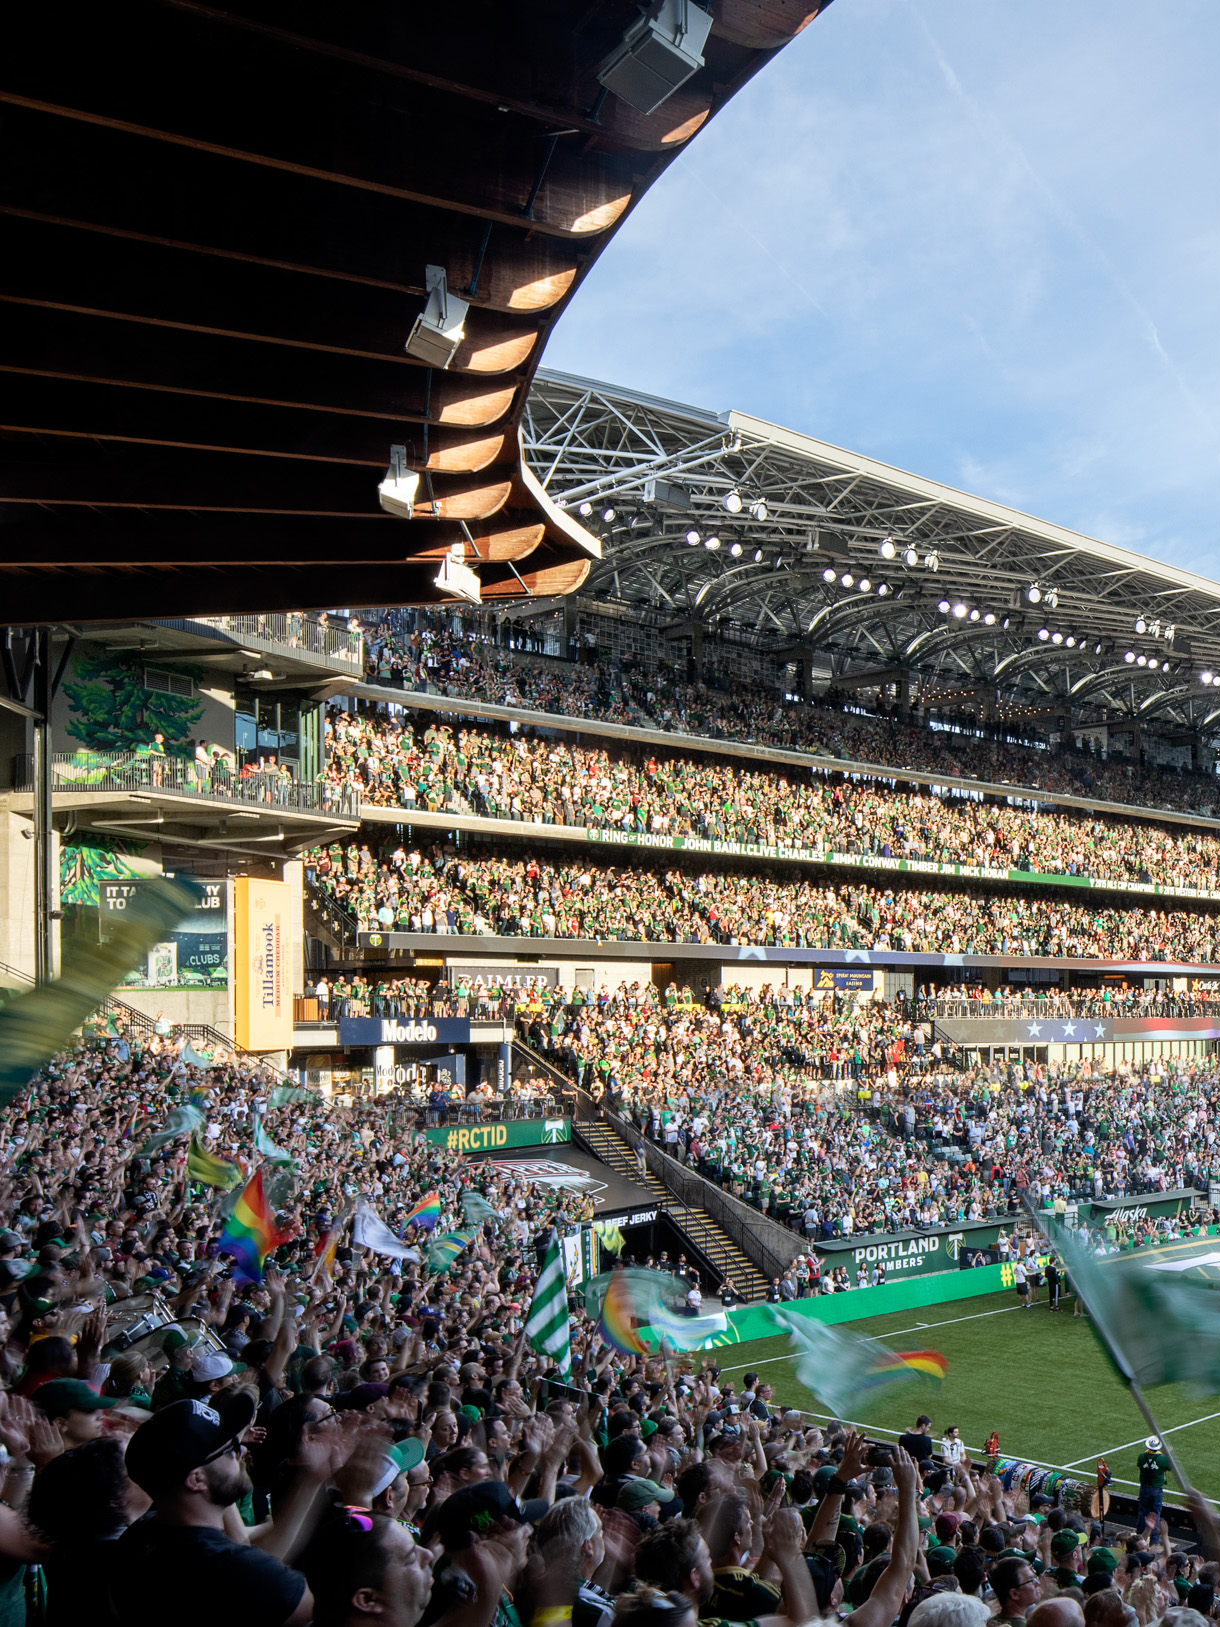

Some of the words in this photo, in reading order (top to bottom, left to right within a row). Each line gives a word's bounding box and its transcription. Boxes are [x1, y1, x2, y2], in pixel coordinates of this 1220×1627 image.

[602, 829, 628, 844] RING
[637, 833, 673, 848] HONOR
[681, 838, 712, 852] JOHN
[713, 841, 741, 854] BAIN
[746, 843, 777, 858] CLIVE
[778, 847, 825, 862] CHARLES
[831, 852, 861, 866] JIMMY
[862, 857, 900, 870] CONWAY
[905, 860, 938, 873] TIMBER
[939, 863, 955, 874] JIM
[959, 865, 980, 877] MICK
[980, 868, 1009, 880] HOBAN
[106, 886, 119, 897] IT
[107, 898, 126, 909] TO
[194, 896, 220, 909] LUB
[189, 954, 220, 965] CLUBS
[262, 922, 274, 1009] Tillamook
[381, 1018, 437, 1043] Modelo
[376, 1064, 394, 1077] Mod
[447, 1124, 507, 1149] #RCTID
[604, 1216, 628, 1228] BEEF
[629, 1210, 658, 1225] JERKY
[1104, 1205, 1148, 1223] Alaska
[855, 1236, 940, 1264] PORTLAND
[874, 1256, 925, 1272] IMBERS
